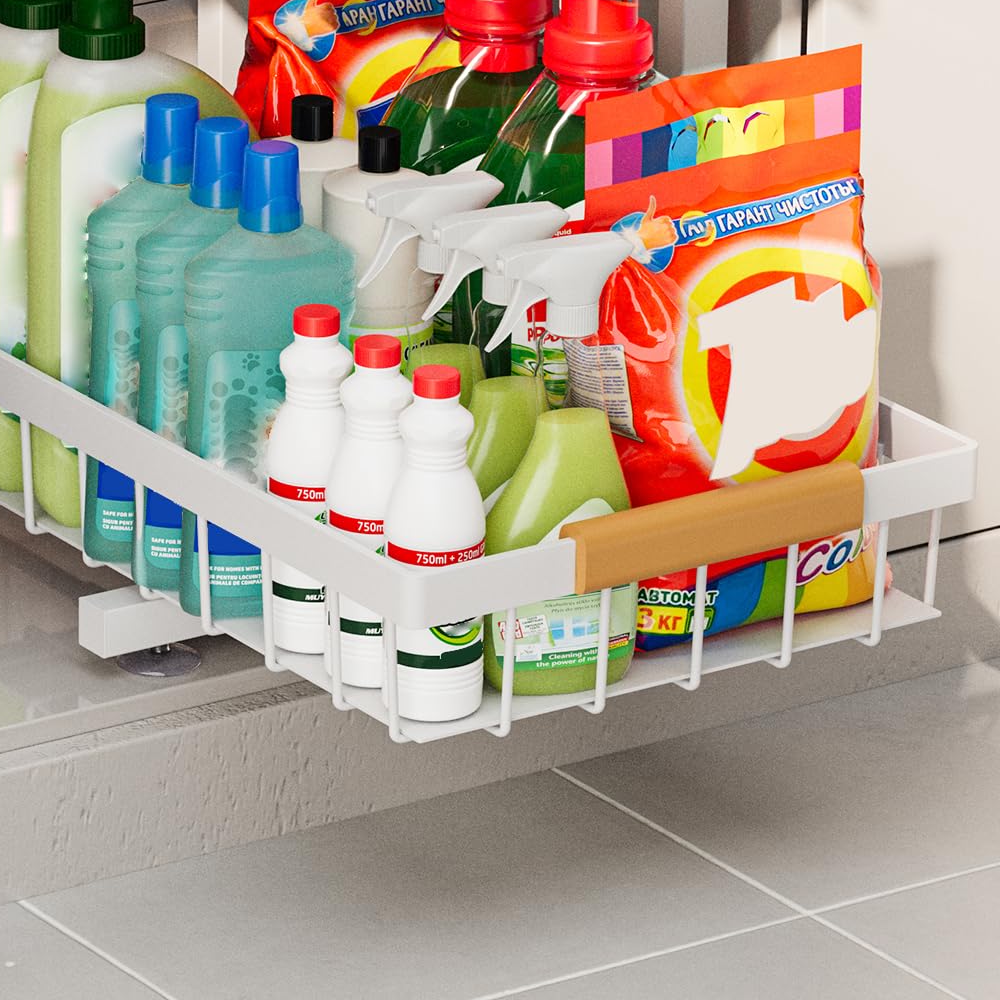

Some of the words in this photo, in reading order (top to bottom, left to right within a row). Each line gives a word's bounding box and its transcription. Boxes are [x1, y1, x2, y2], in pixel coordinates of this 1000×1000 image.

[718, 203, 774, 233] ГАРАНТ
[415, 553, 447, 565] 750ml
[457, 545, 480, 563] 250ml
[637, 607, 654, 628] 3
[657, 614, 683, 632] КГ
[548, 650, 582, 660] Cleaning
[551, 657, 578, 667] power
